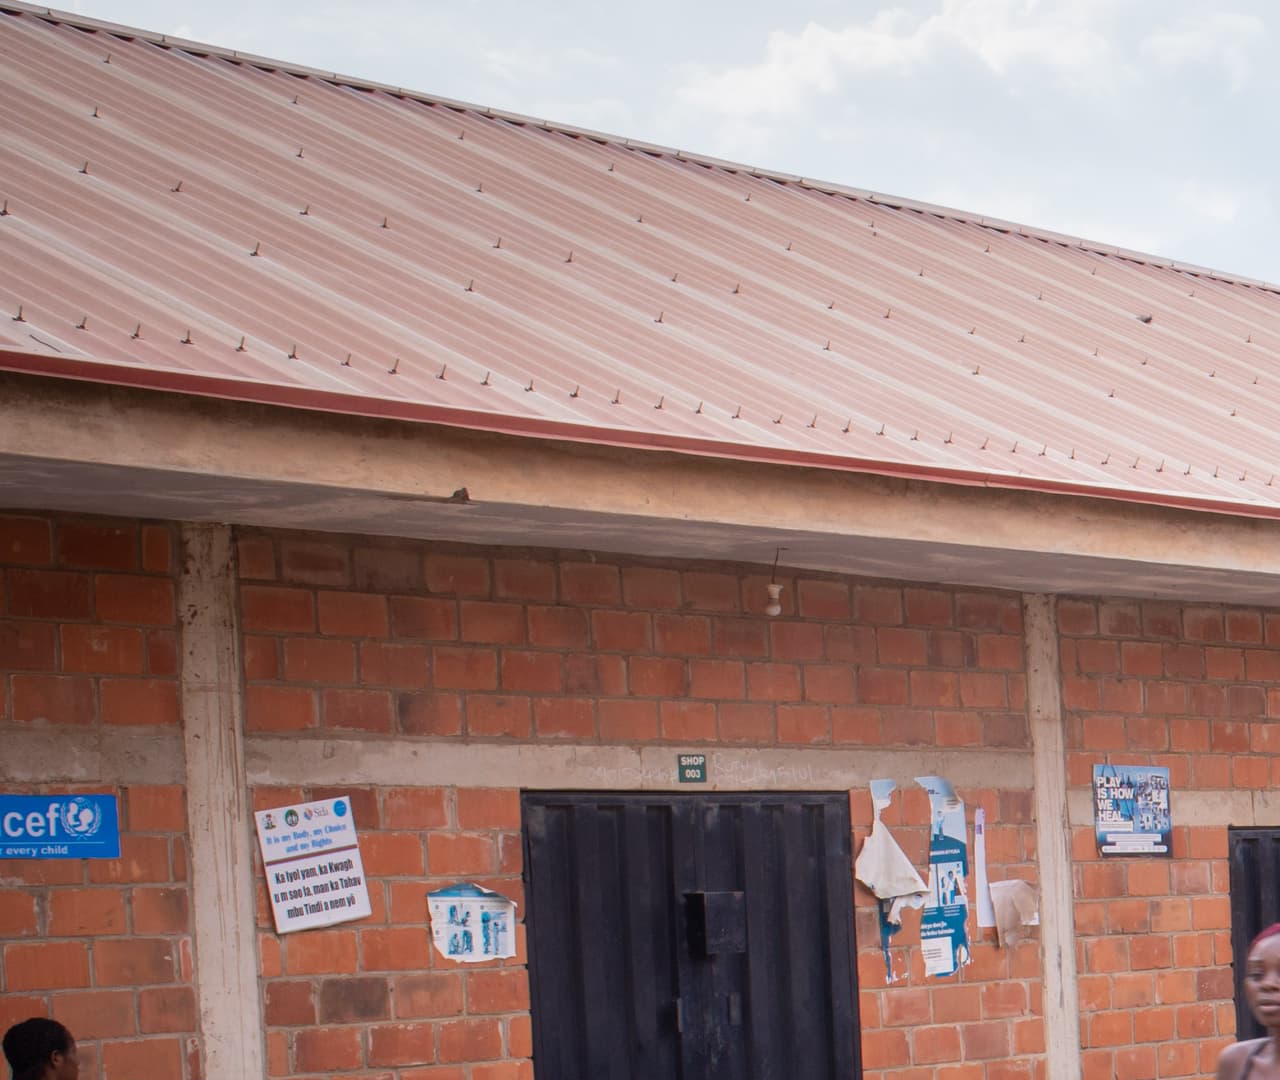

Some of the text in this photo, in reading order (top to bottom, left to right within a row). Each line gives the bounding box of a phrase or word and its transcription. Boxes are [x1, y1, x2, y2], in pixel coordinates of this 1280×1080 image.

[681, 756, 705, 765] SHOP
[685, 769, 701, 778] 003
[1096, 776, 1121, 787] PLAY
[1097, 788, 1134, 799] IS HOW
[1097, 799, 1113, 810] WE
[0, 803, 60, 838] cef
[1098, 810, 1124, 822] HEAL
[6, 845, 68, 857] every child
[275, 872, 286, 884] Ka
[318, 863, 328, 875] ka
[328, 858, 354, 872] Kwagh
[281, 891, 288, 902] m
[288, 889, 303, 900] soo
[313, 883, 330, 895] man
[330, 879, 340, 891] ka
[287, 906, 304, 919] mbu
[304, 901, 323, 915] Tindi
[324, 901, 330, 911] a
[330, 897, 346, 909] nem
